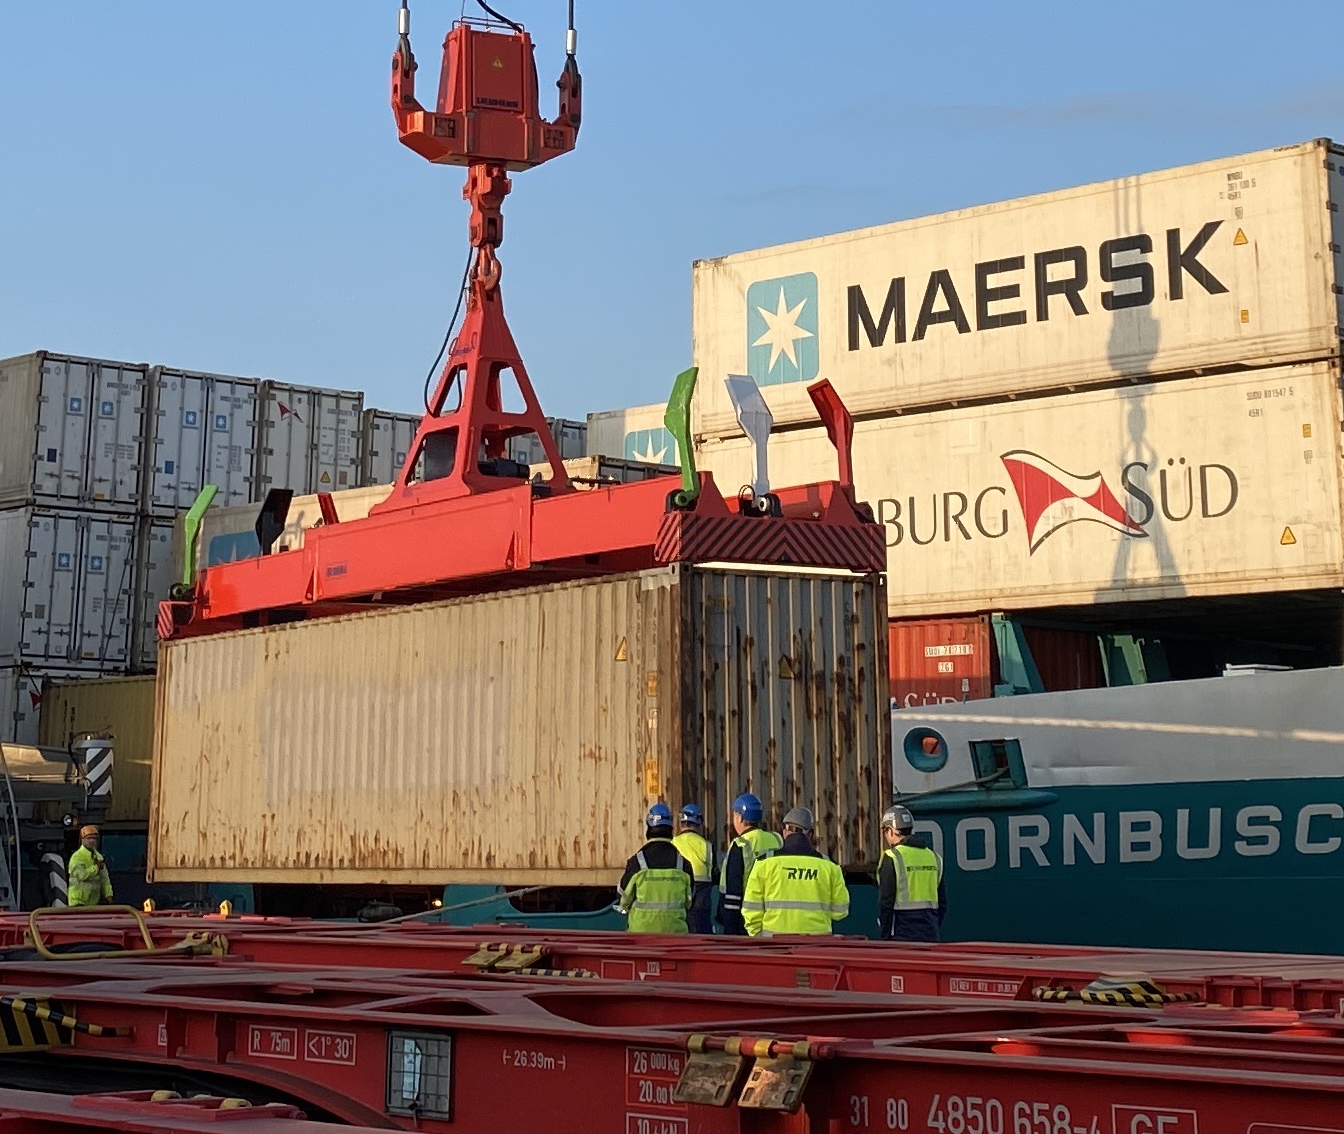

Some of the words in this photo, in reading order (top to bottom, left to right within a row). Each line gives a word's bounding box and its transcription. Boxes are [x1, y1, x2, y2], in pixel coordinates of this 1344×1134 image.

[847, 219, 1230, 352] MAERSK
[1121, 456, 1239, 527] SÜD
[787, 866, 819, 882] RTM
[253, 1029, 261, 1051] R
[270, 1031, 291, 1054] 75m
[334, 1036, 353, 1060] 30'
[513, 1050, 556, 1072] 26.39m
[633, 1051, 648, 1074] 26
[667, 1053, 680, 1076] kg
[638, 1080, 668, 1105] 20.00
[849, 1095, 869, 1128] 31
[886, 1097, 909, 1131] 80
[927, 1093, 1004, 1134] 4850
